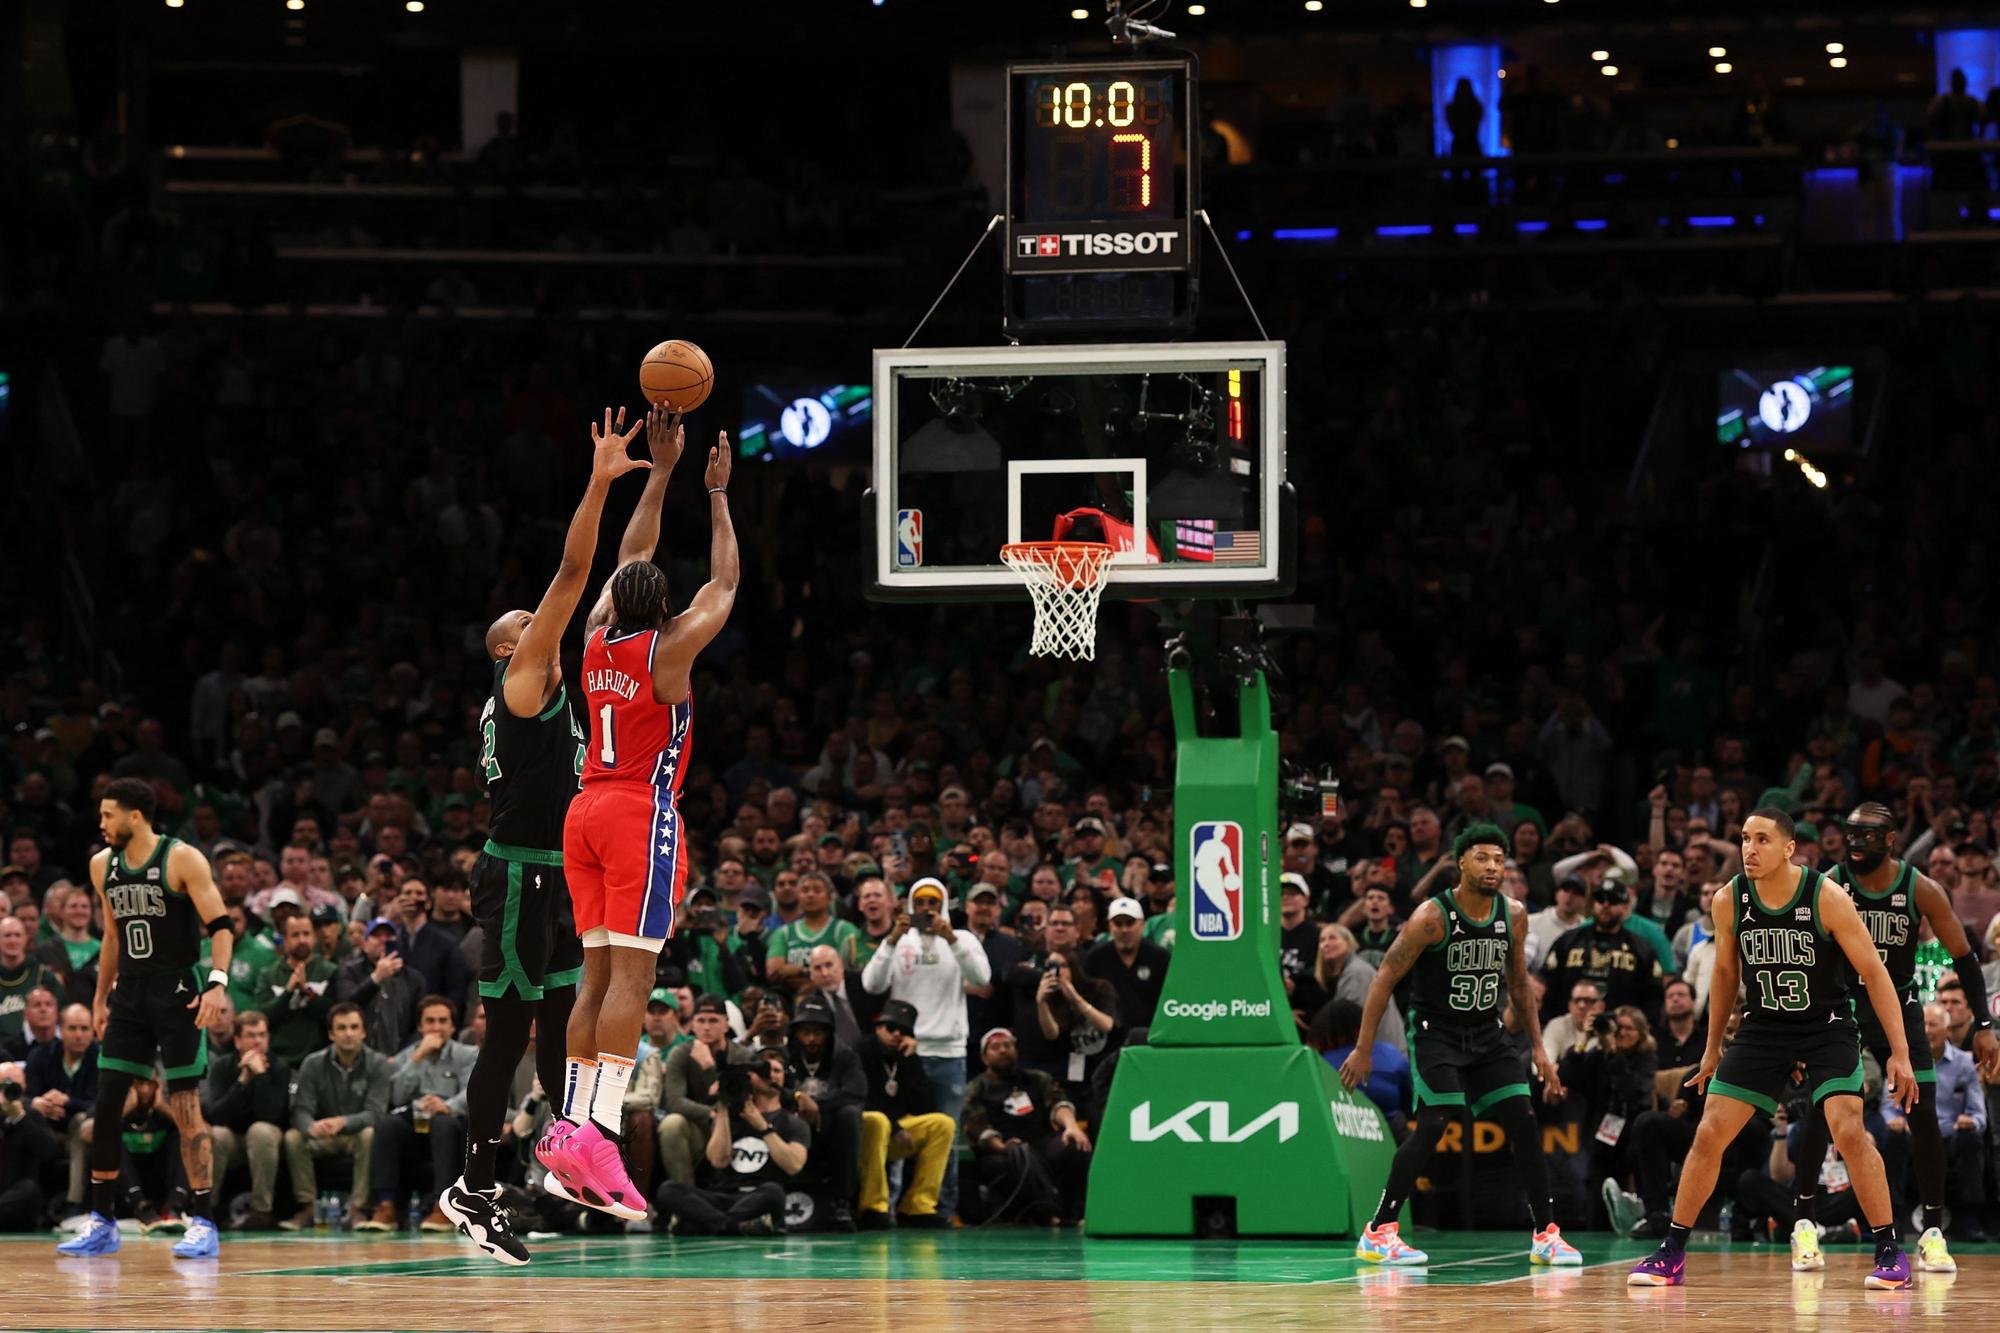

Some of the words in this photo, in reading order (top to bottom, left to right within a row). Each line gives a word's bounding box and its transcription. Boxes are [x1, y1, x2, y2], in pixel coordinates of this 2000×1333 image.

[1052, 81, 1135, 128] 10.0
[1112, 133, 1151, 208] 7
[1062, 231, 1179, 256] TISSOT
[587, 668, 641, 702] HARDEN
[599, 703, 616, 766] 1
[106, 884, 166, 919] CELTICS
[1742, 892, 1749, 903] 6
[1794, 907, 1812, 915] VISTA
[1198, 912, 1224, 933] NBA
[1794, 914, 1812, 922] PRINT
[125, 919, 154, 960] 0
[1447, 938, 1508, 972] CELTICS
[1740, 928, 1816, 966] CELTICS
[1449, 973, 1499, 1011] 36
[1756, 970, 1811, 1011] 13
[1163, 1000, 1228, 1021] Google
[1231, 1000, 1271, 1017] Pixel
[1129, 1100, 1300, 1143] KIA
[731, 1148, 769, 1164] TNT
